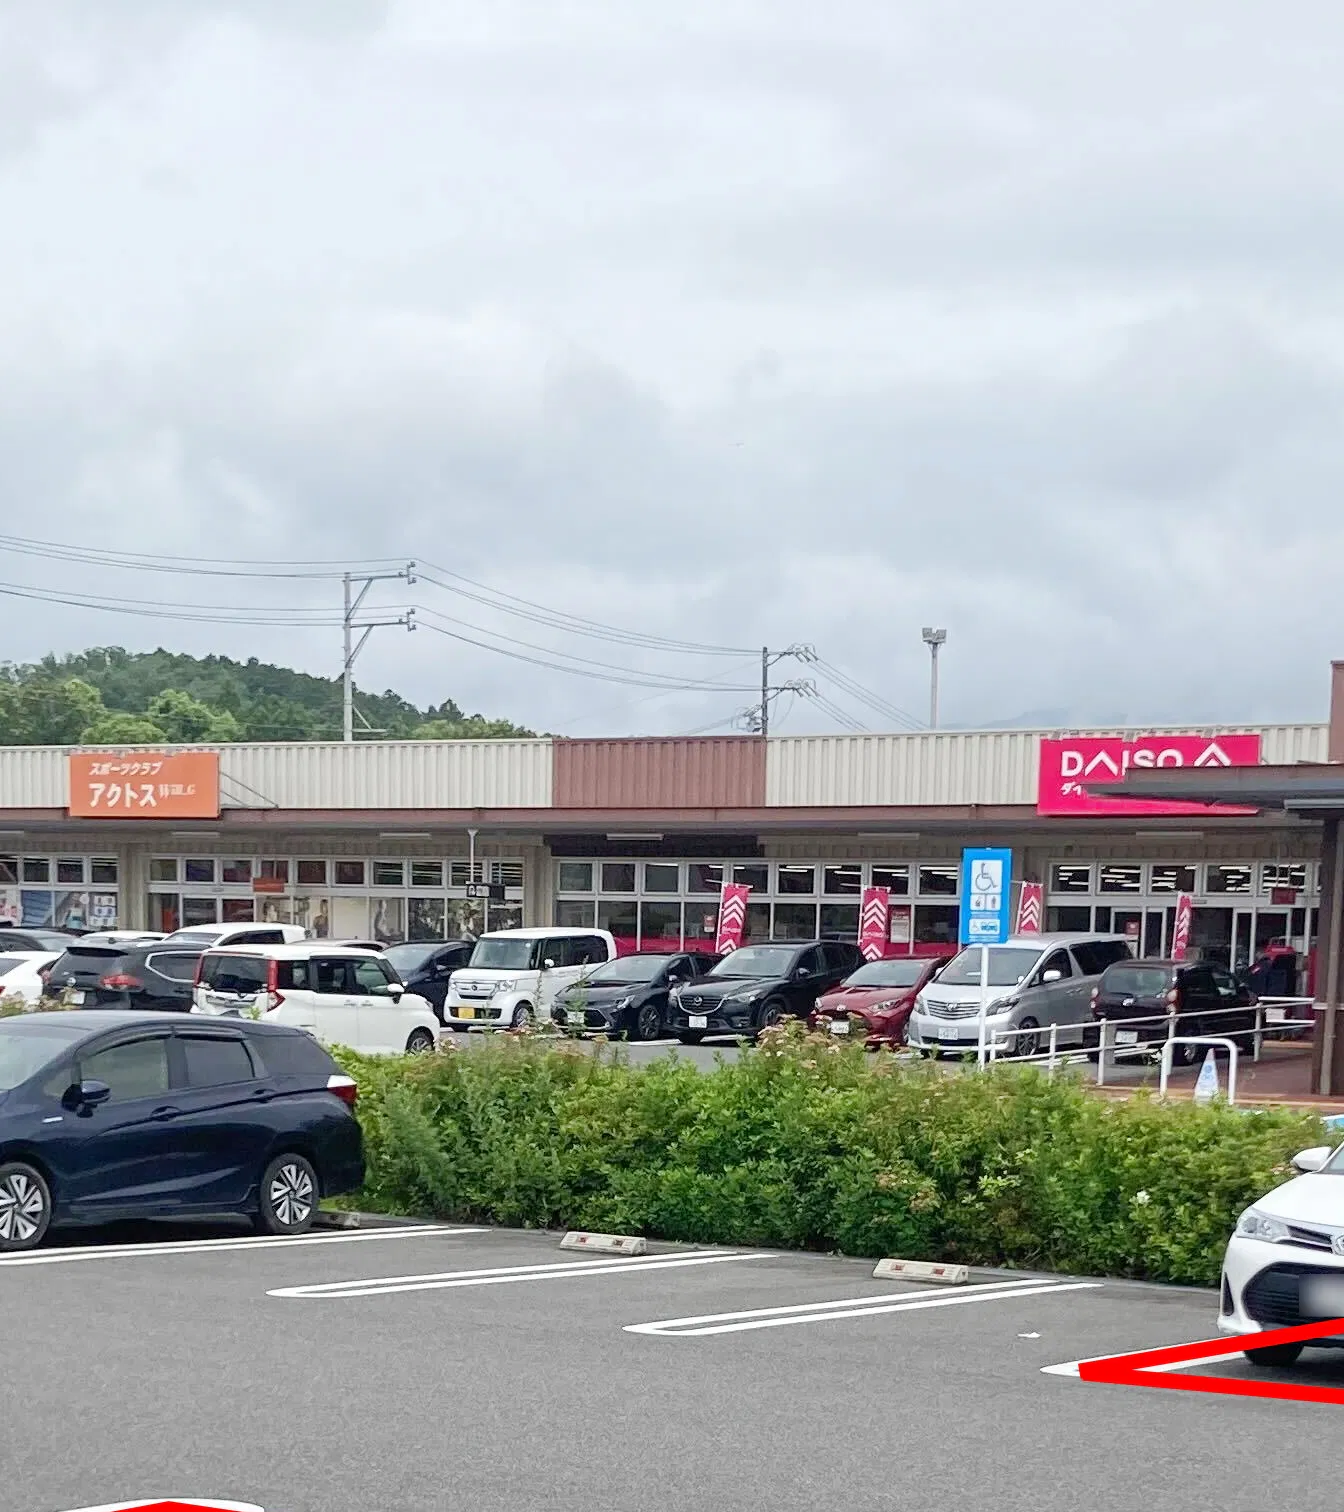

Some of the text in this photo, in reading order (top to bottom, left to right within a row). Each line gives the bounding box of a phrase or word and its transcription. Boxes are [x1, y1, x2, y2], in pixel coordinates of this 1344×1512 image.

[89, 762, 163, 776] スポーツクラブ
[89, 783, 157, 808] アクトス
